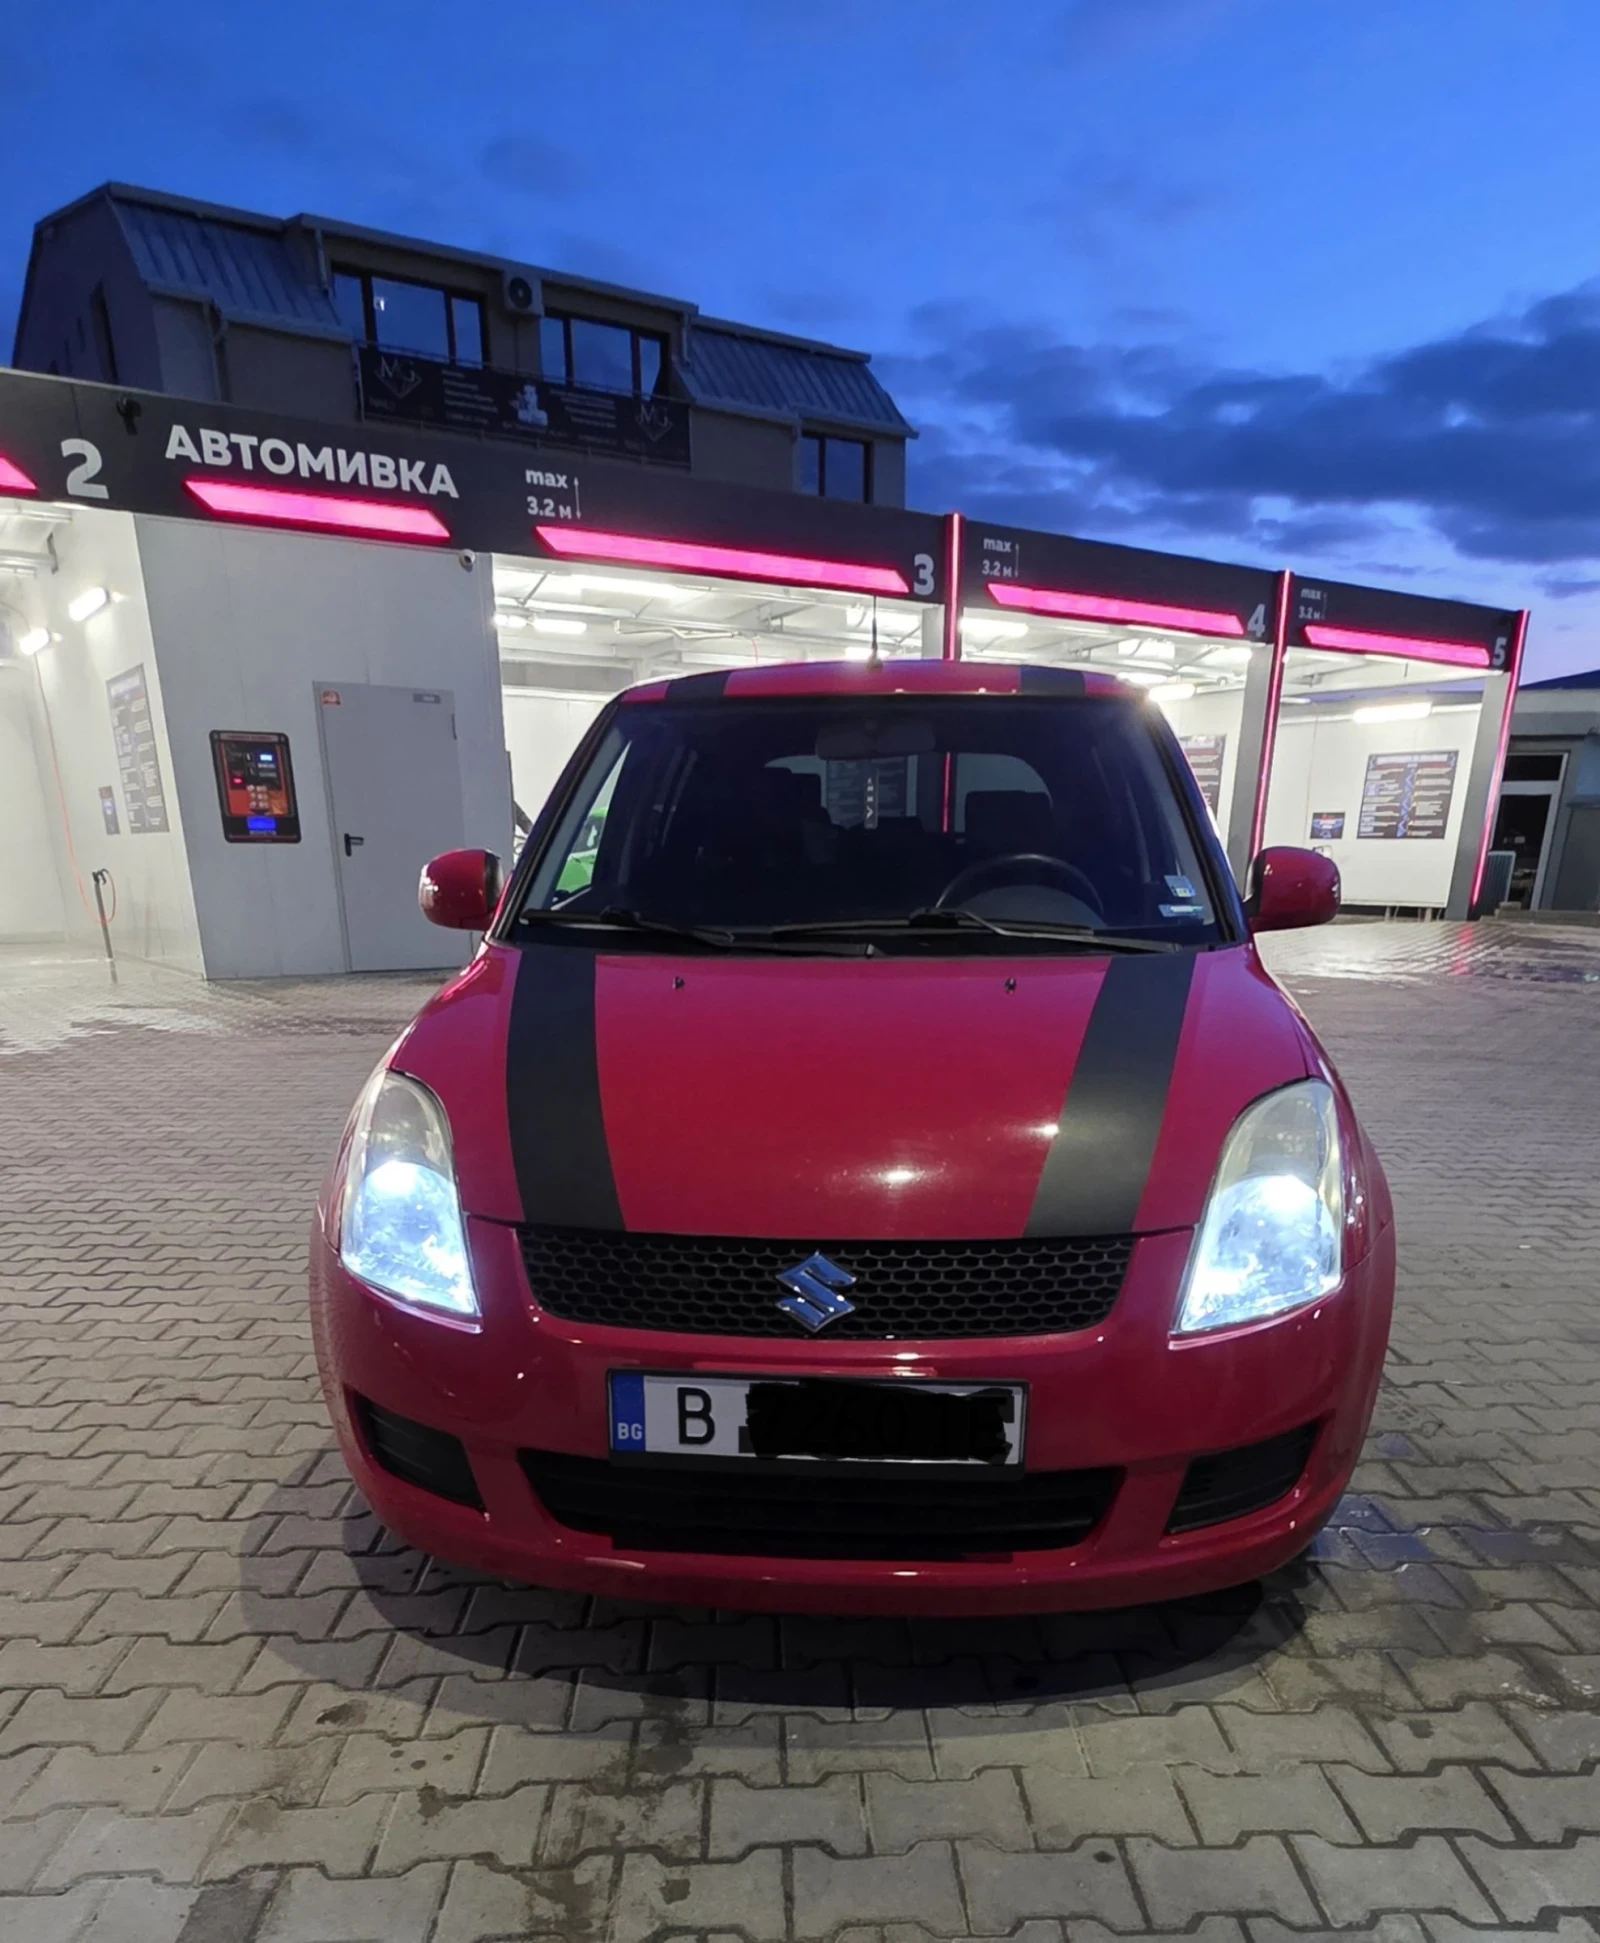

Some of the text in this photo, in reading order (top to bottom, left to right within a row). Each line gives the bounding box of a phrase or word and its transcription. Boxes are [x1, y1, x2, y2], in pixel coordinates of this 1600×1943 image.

[60, 438, 110, 499] 2
[165, 424, 460, 499] АВТОМИВКА
[525, 469, 569, 489] max
[526, 495, 556, 518] 3.2
[983, 537, 1012, 552] max
[913, 553, 935, 596] 3
[981, 559, 1002, 577] 3.2
[1300, 587, 1322, 600] max
[1247, 603, 1266, 637] 4
[1298, 605, 1313, 620] 3.2
[1492, 636, 1508, 666] 5
[617, 1421, 644, 1441] BG
[677, 1386, 716, 1446] B
